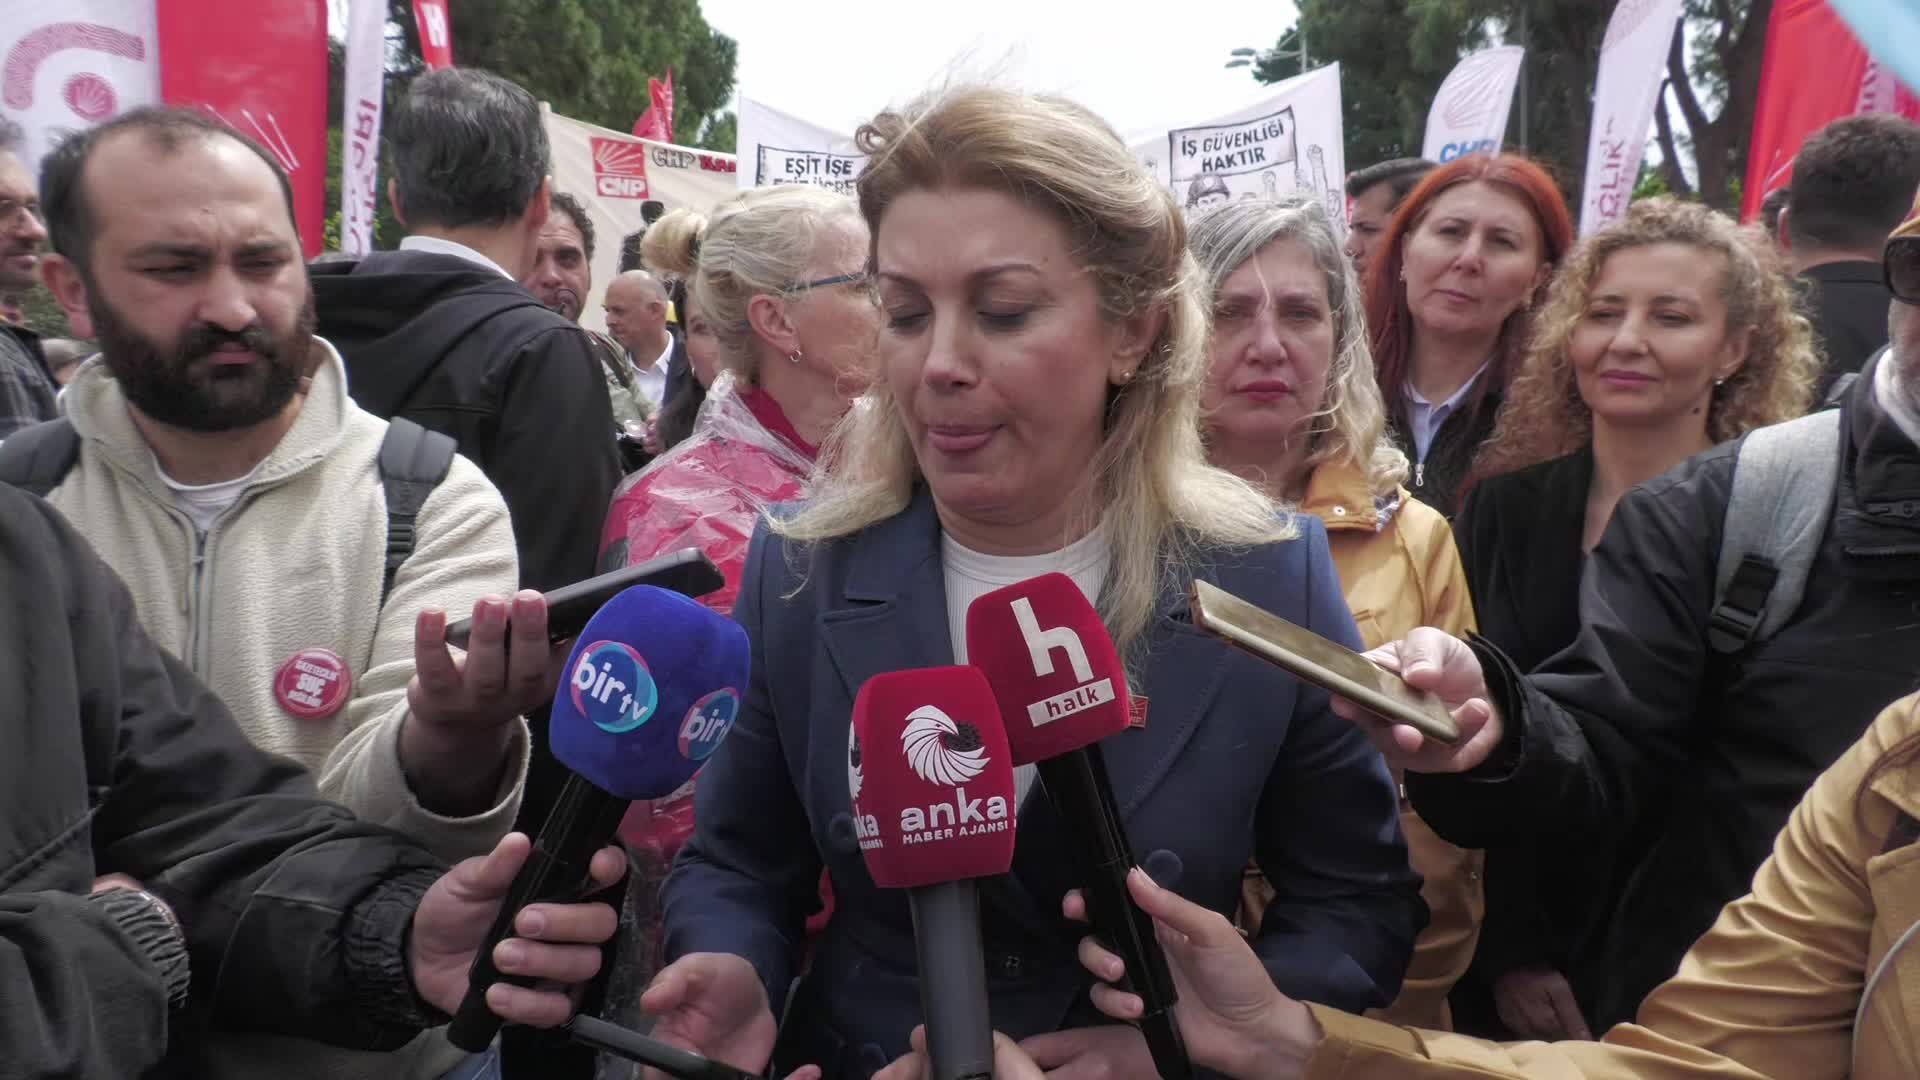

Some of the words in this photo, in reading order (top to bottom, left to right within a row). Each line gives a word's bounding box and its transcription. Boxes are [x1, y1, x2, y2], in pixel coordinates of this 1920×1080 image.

[1181, 137, 1197, 157] İŞ
[1203, 118, 1285, 153] GÜVENLİĞİ
[785, 154, 821, 177] EŞİT
[825, 154, 854, 177] İŞE
[1202, 146, 1266, 173] HAKTIR
[599, 176, 647, 196] CHP
[1010, 597, 1094, 684] h
[571, 652, 626, 704] bir
[619, 693, 649, 720] tv
[1045, 687, 1100, 718] halk
[901, 787, 1007, 832] anka
[902, 828, 954, 845] HABER
[959, 820, 1009, 837] AJANSI
